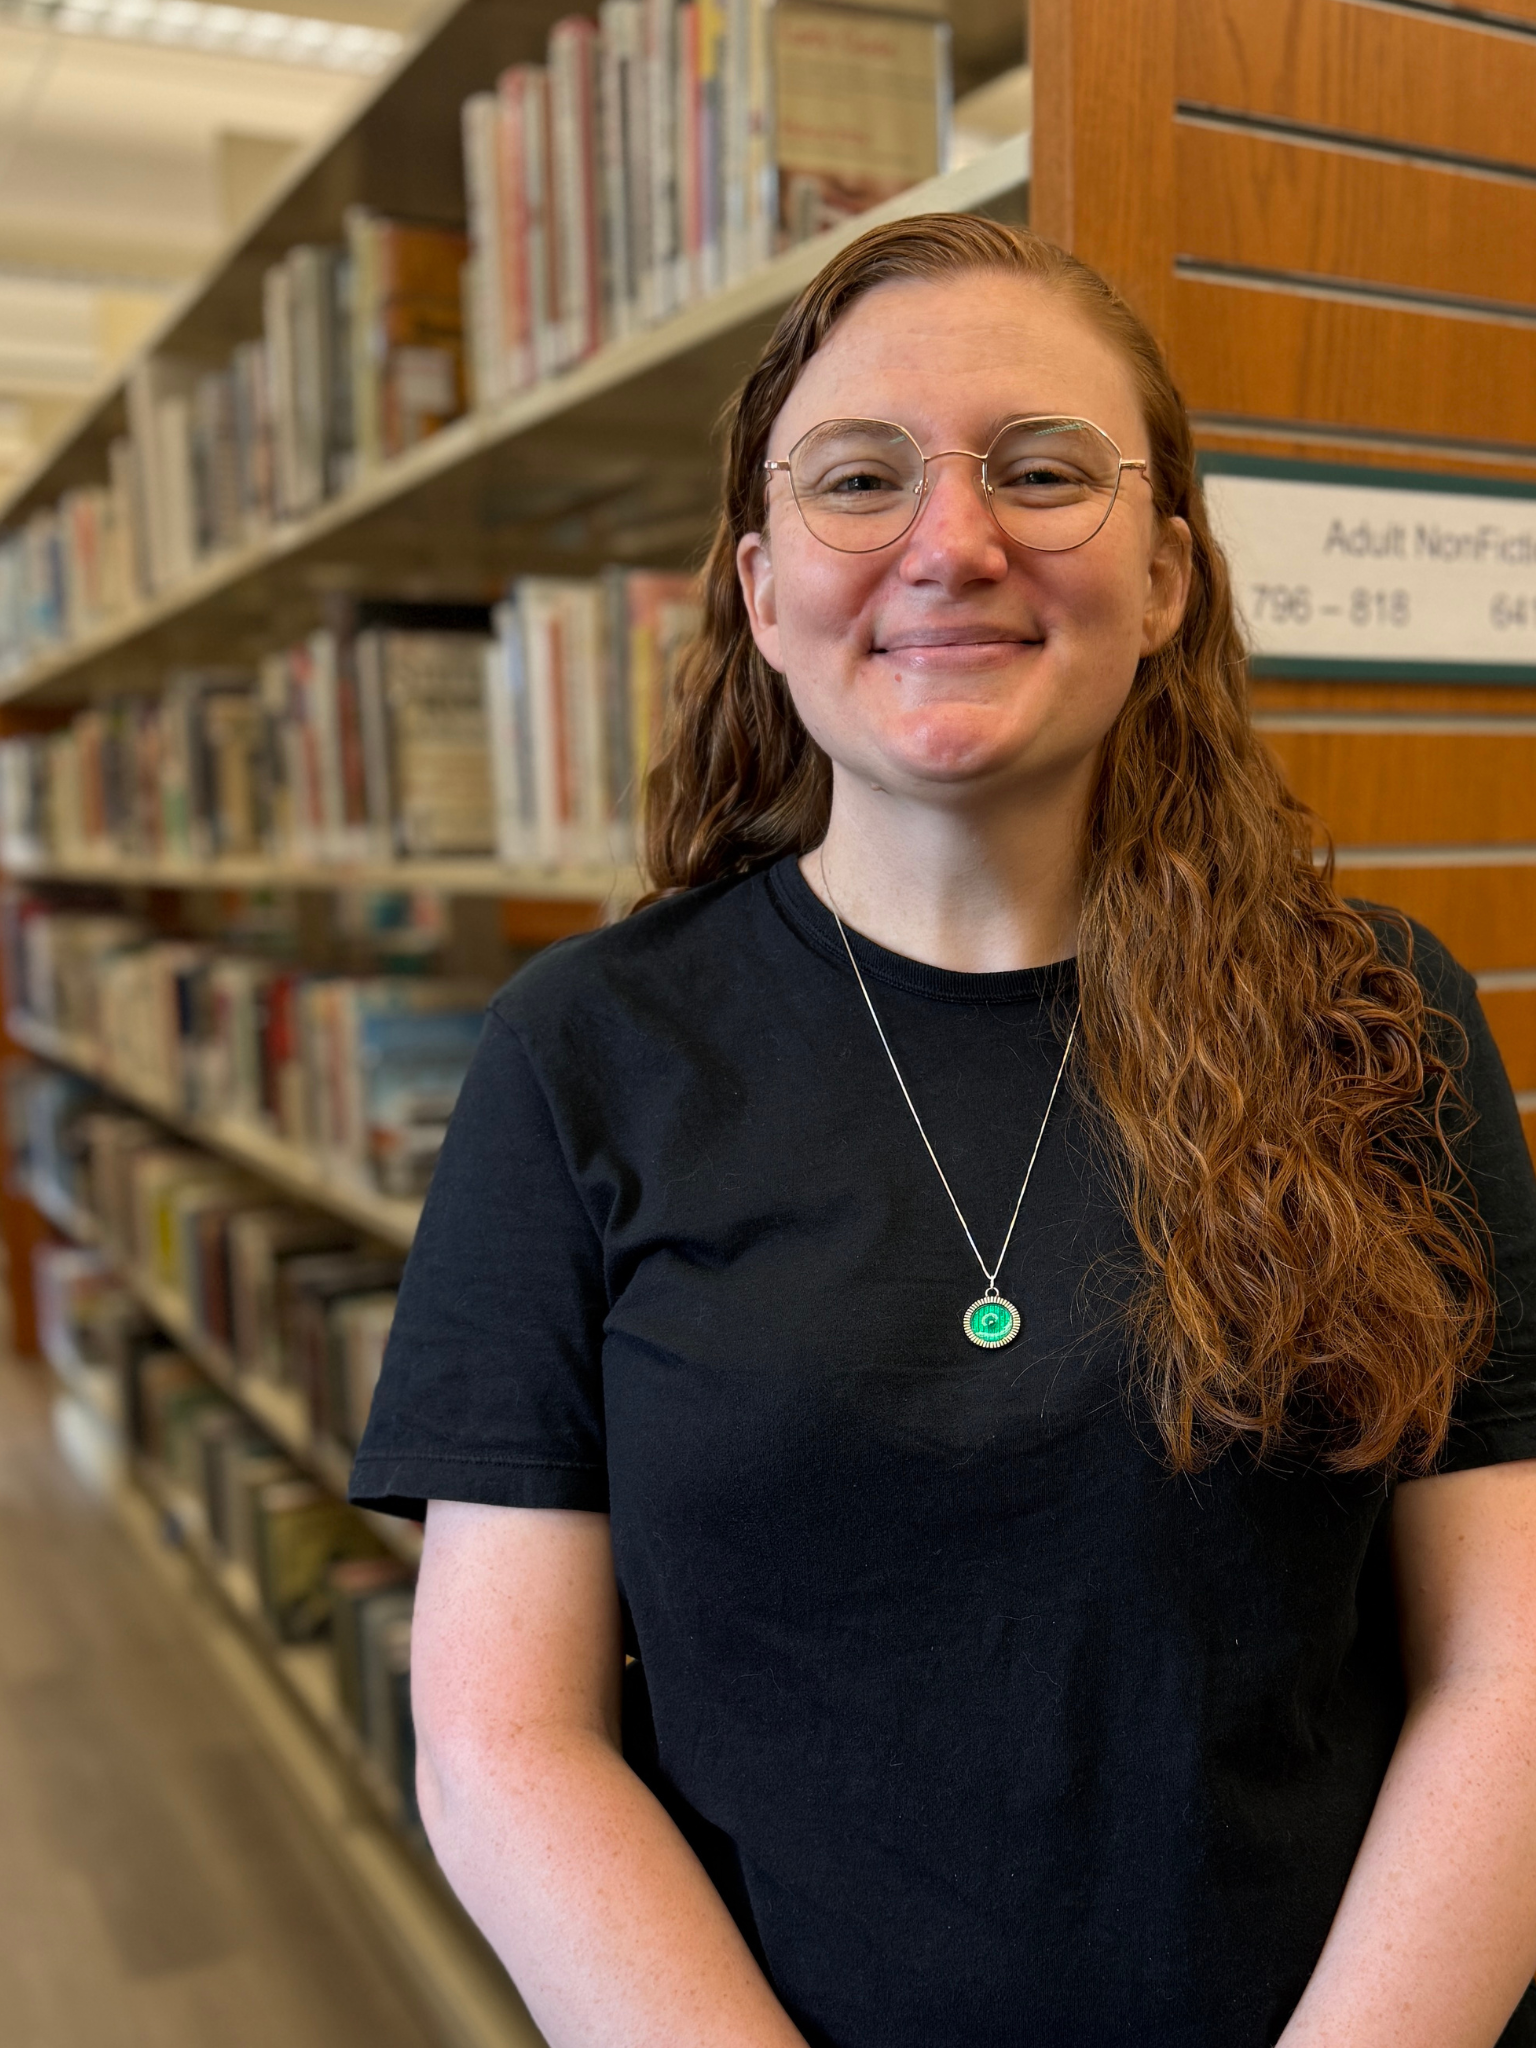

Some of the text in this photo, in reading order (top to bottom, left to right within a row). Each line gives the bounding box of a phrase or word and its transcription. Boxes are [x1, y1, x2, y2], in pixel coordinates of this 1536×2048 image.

[1325, 518, 1405, 557] Adult
[1252, 585, 1312, 625] 796
[1349, 587, 1410, 627] 818
